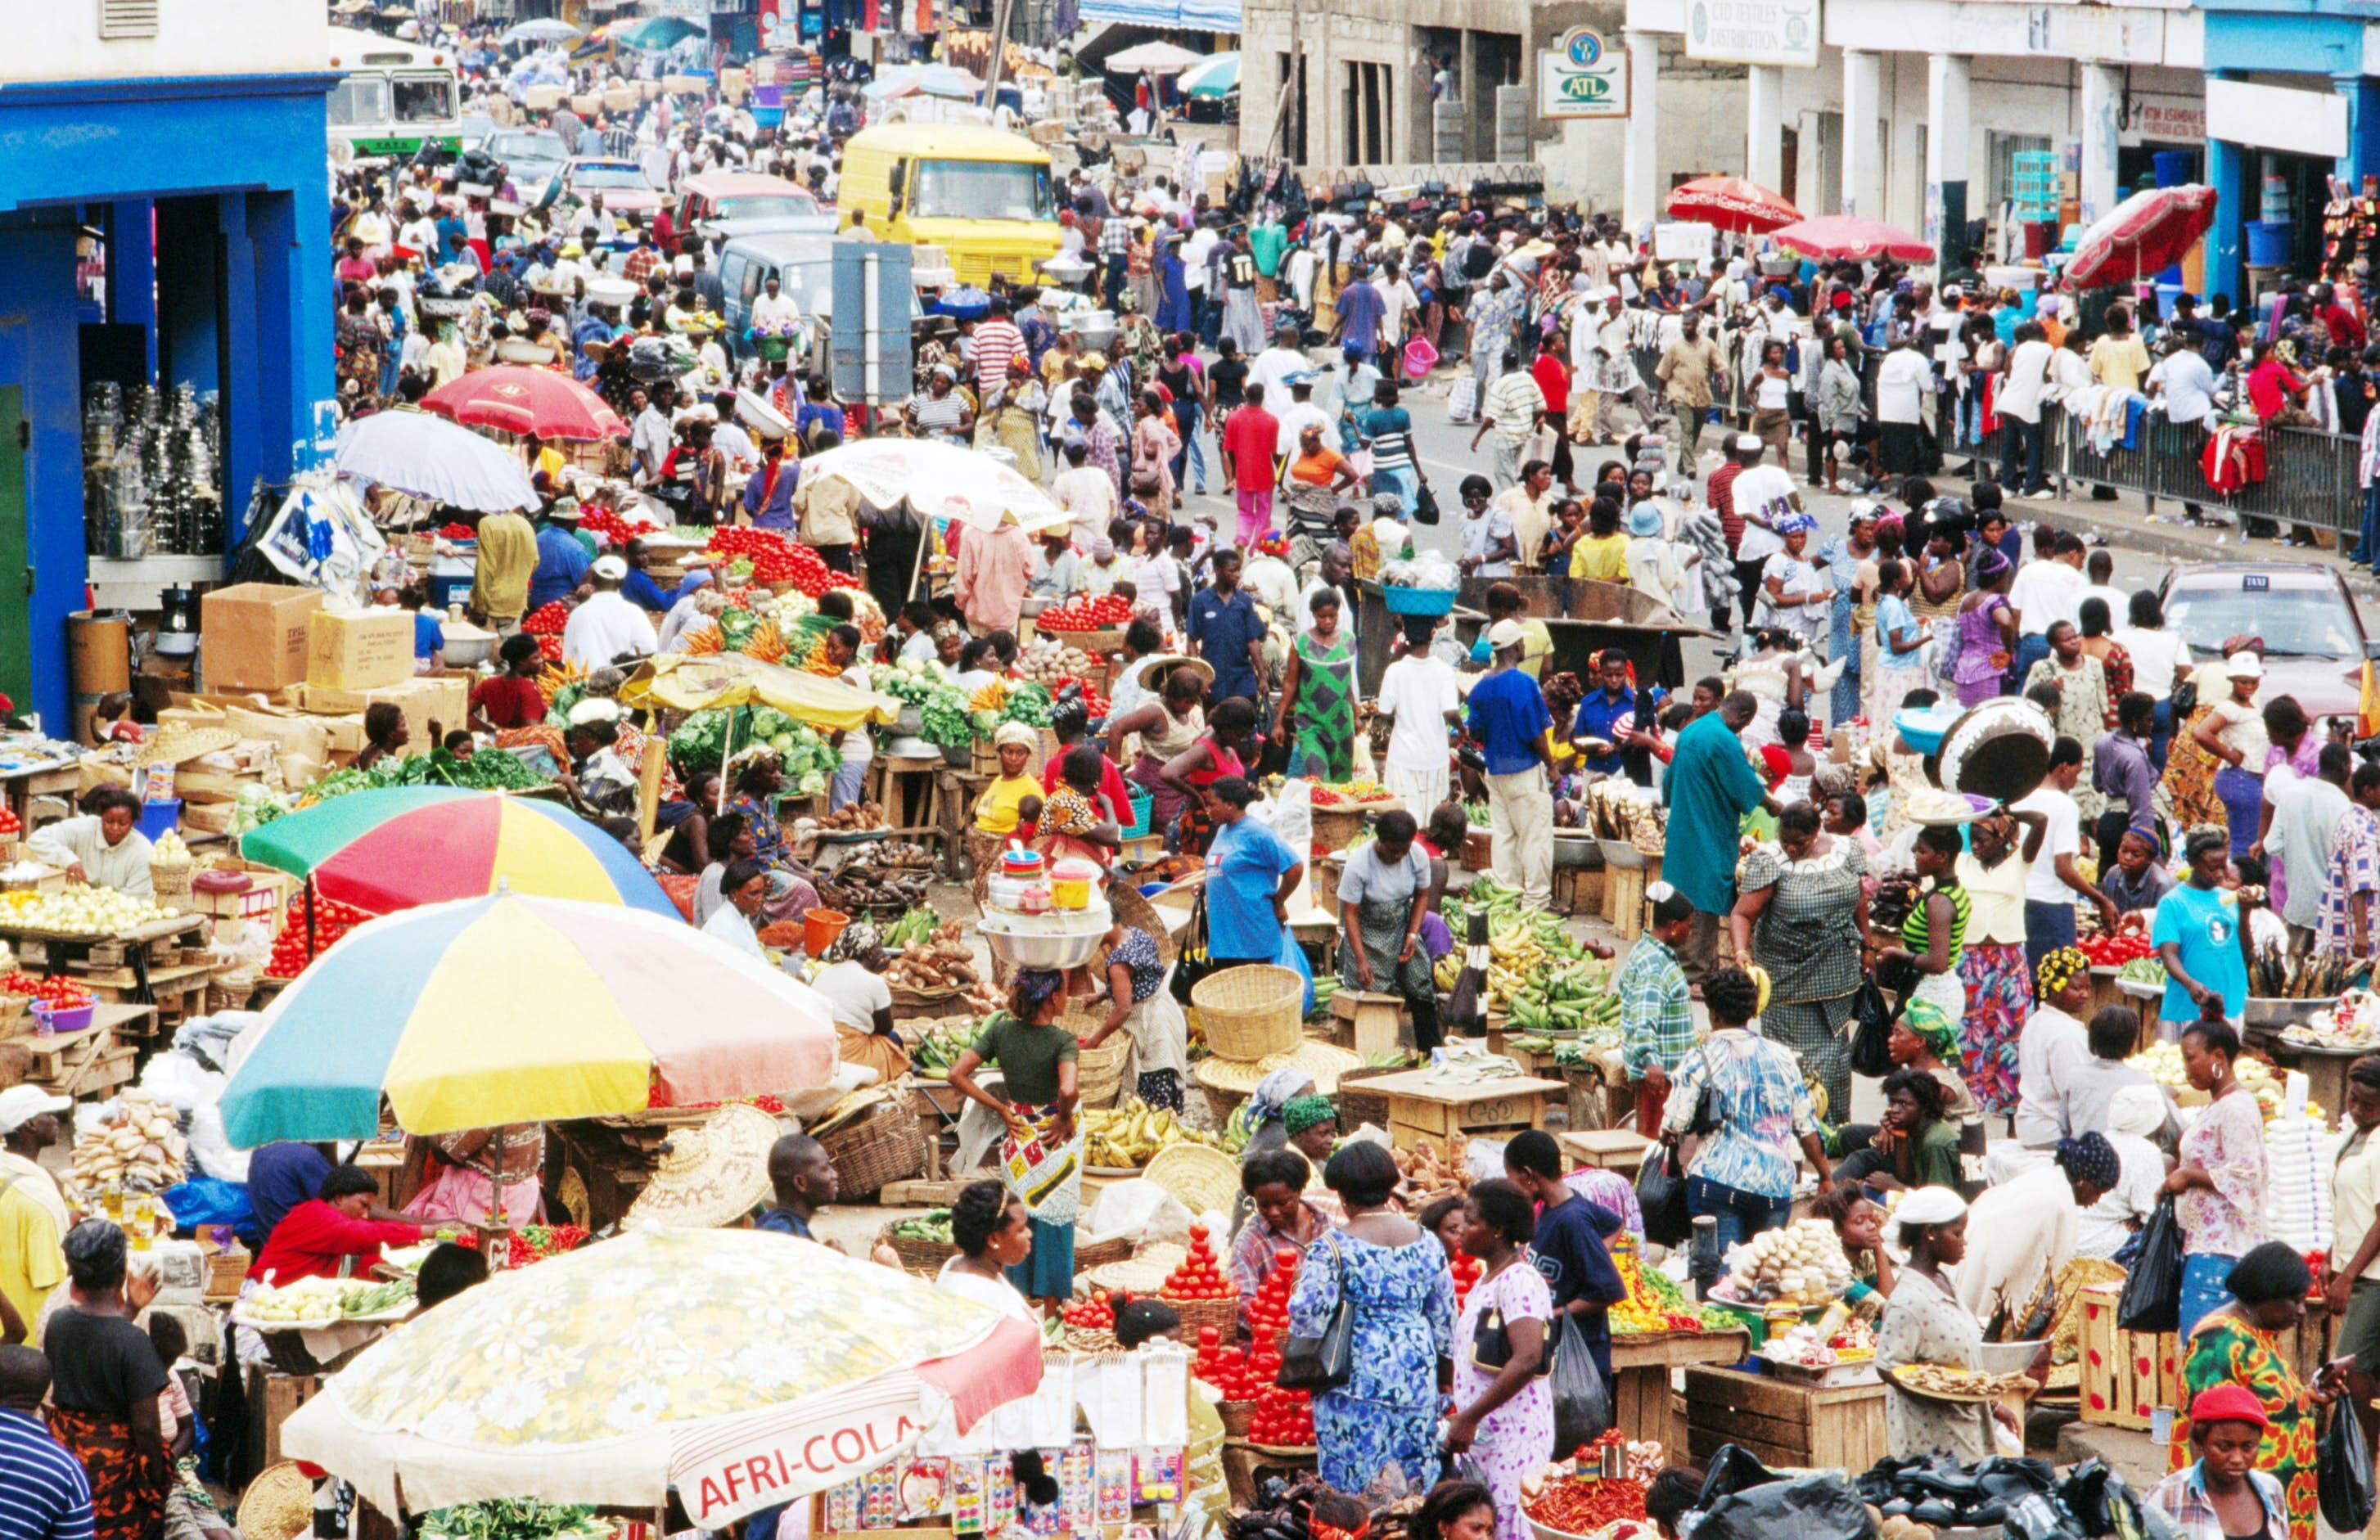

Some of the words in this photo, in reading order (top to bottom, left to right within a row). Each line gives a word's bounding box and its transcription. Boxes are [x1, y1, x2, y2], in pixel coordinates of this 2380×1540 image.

[1734, 3, 1777, 23] TEXTILES
[1711, 28, 1779, 50] DISTRIBUTION
[1568, 77, 1603, 96] ATL
[1721, 195, 1772, 219] Coca-Cola
[2245, 576, 2267, 587] TAXI
[700, 1415, 927, 1520] AFRI-COLA
